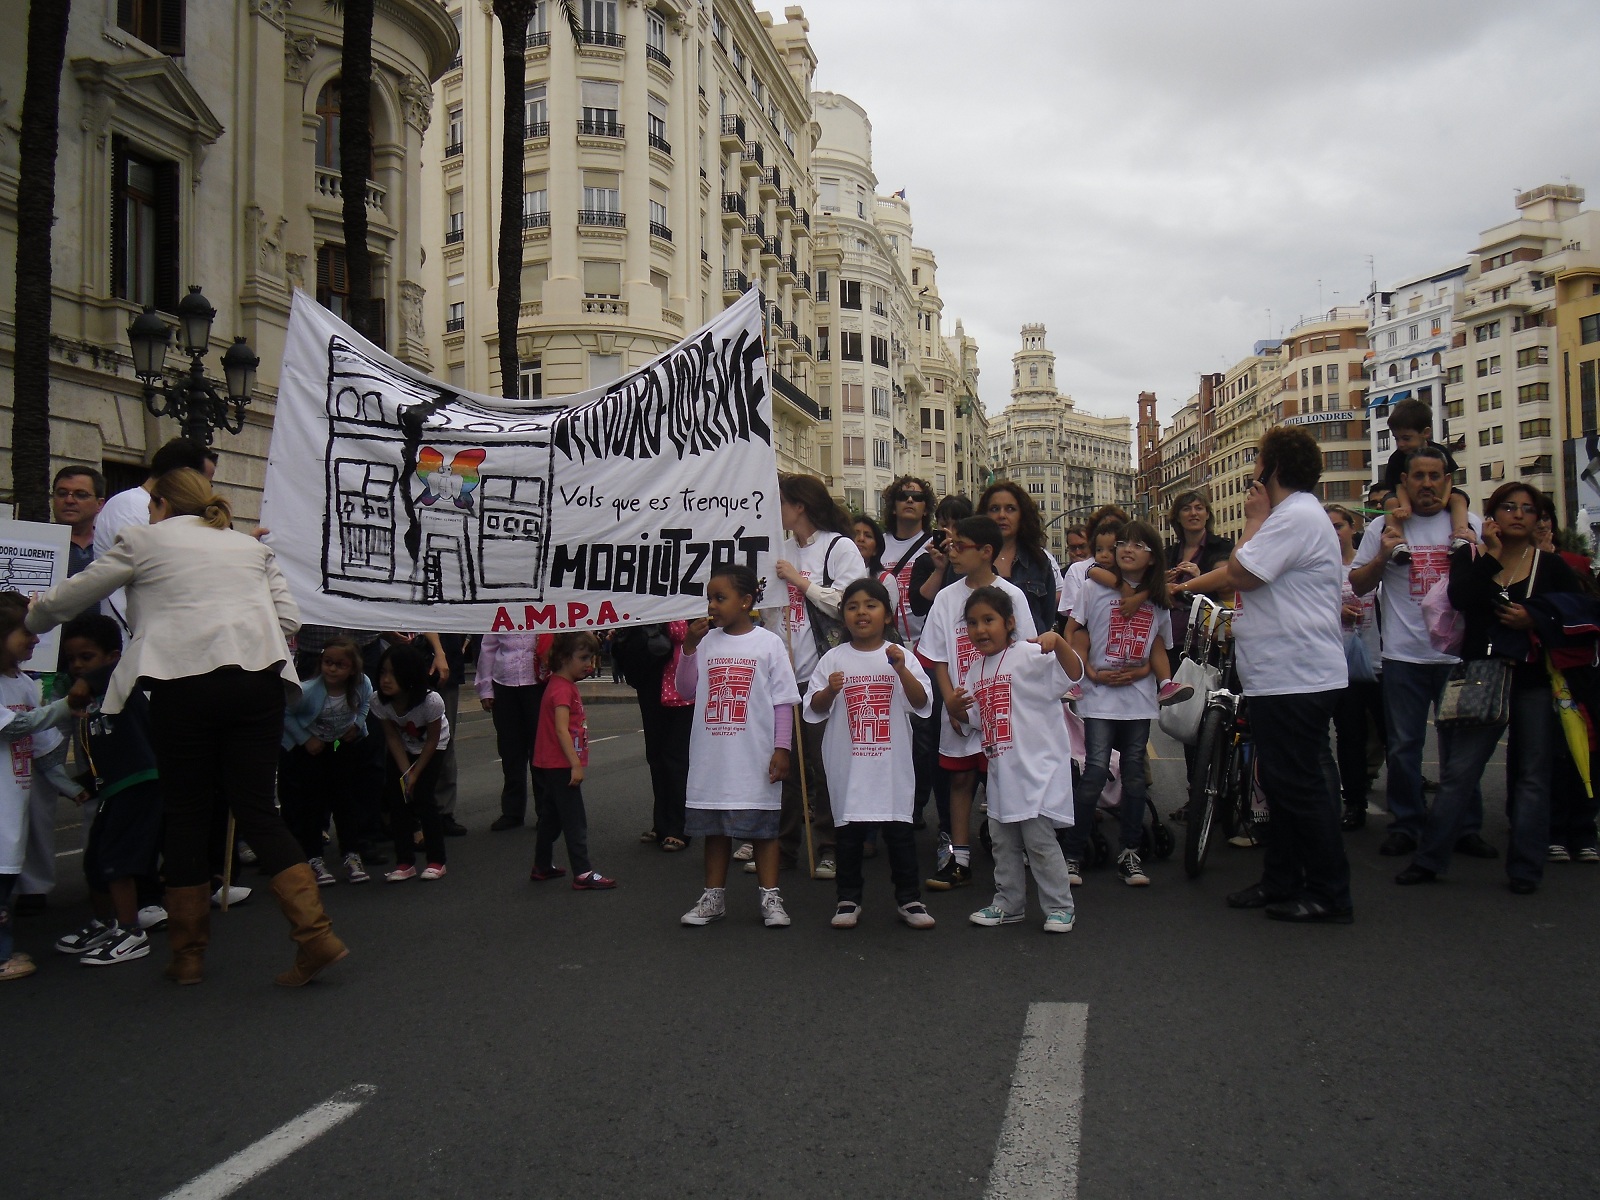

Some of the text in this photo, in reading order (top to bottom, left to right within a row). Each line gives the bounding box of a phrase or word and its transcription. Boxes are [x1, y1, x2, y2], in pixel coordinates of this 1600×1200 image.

[1307, 412, 1353, 423] LONDRES
[560, 485, 604, 508] Vols
[612, 497, 641, 522] que
[649, 496, 671, 511] es
[20, 547, 55, 560] LLORENTE
[491, 600, 630, 632] A.M.P.A.
[734, 657, 757, 667] LLORENTE
[850, 674, 871, 684] TEODORO
[872, 674, 895, 683] LLORENTE
